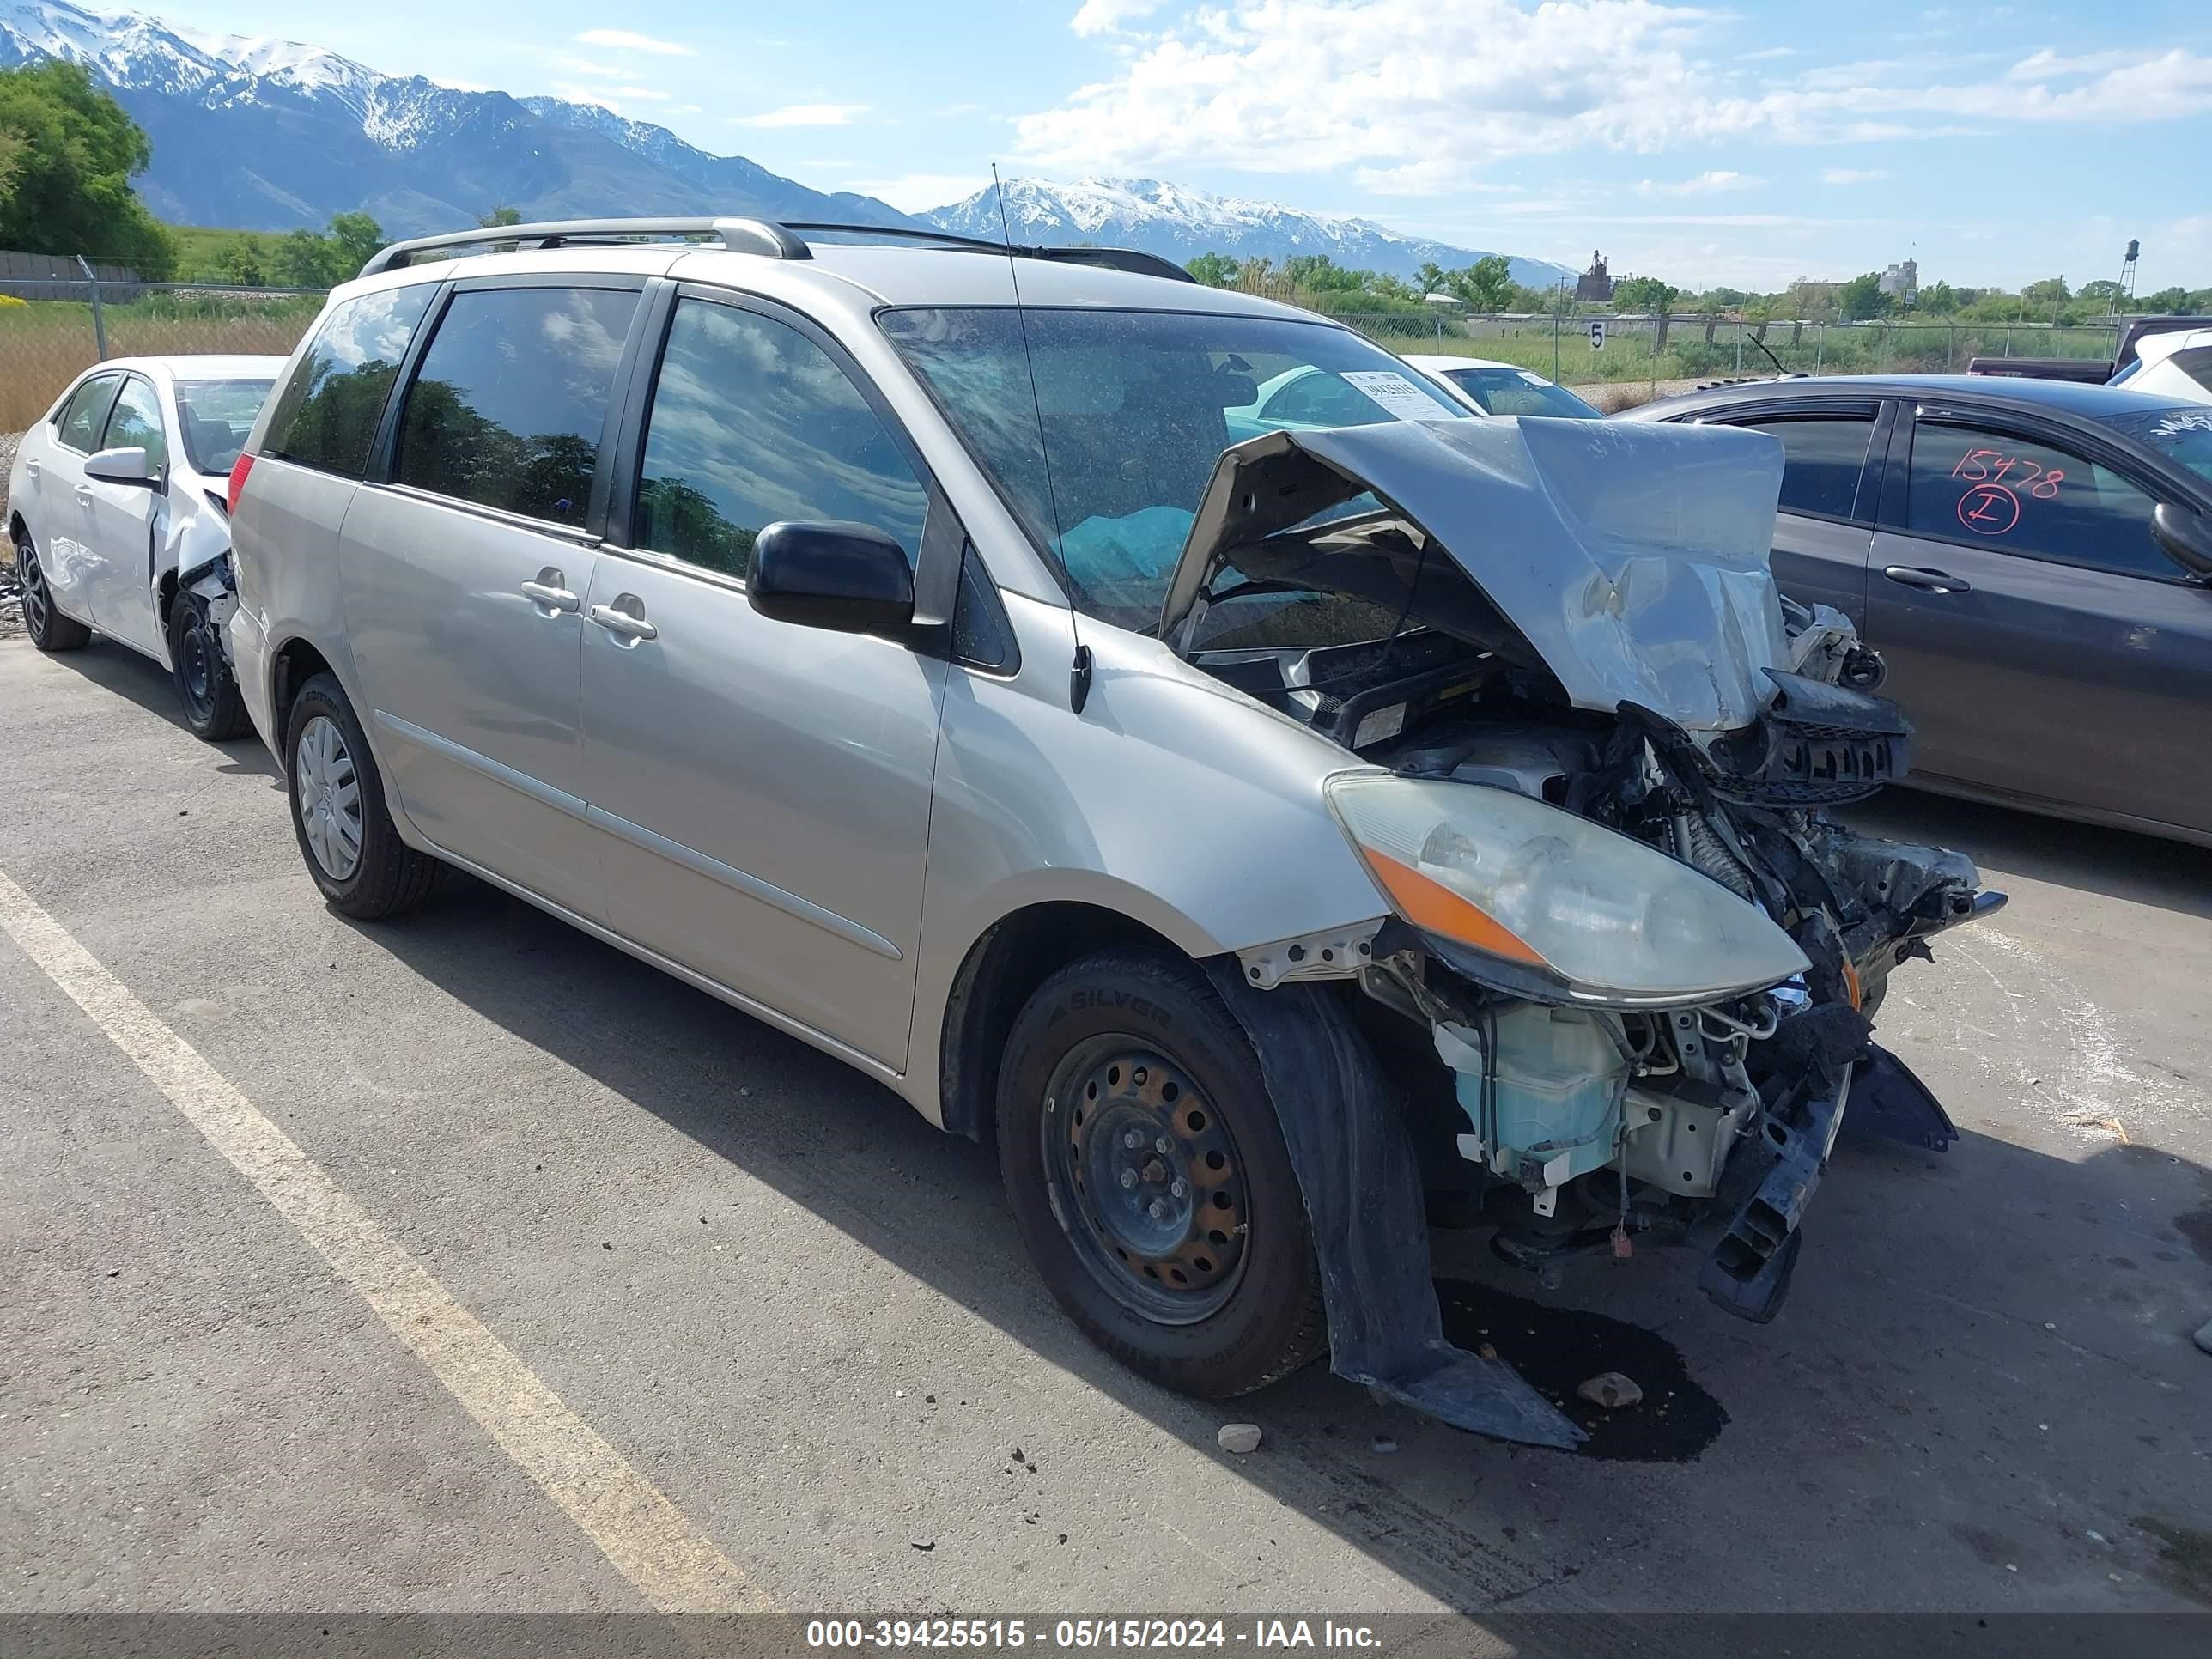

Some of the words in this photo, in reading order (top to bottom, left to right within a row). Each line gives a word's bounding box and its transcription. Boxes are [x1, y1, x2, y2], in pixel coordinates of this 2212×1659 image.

[1591, 323, 1603, 349] 5
[1951, 447, 2064, 499] 15478
[1070, 988, 1174, 1030] SILVER
